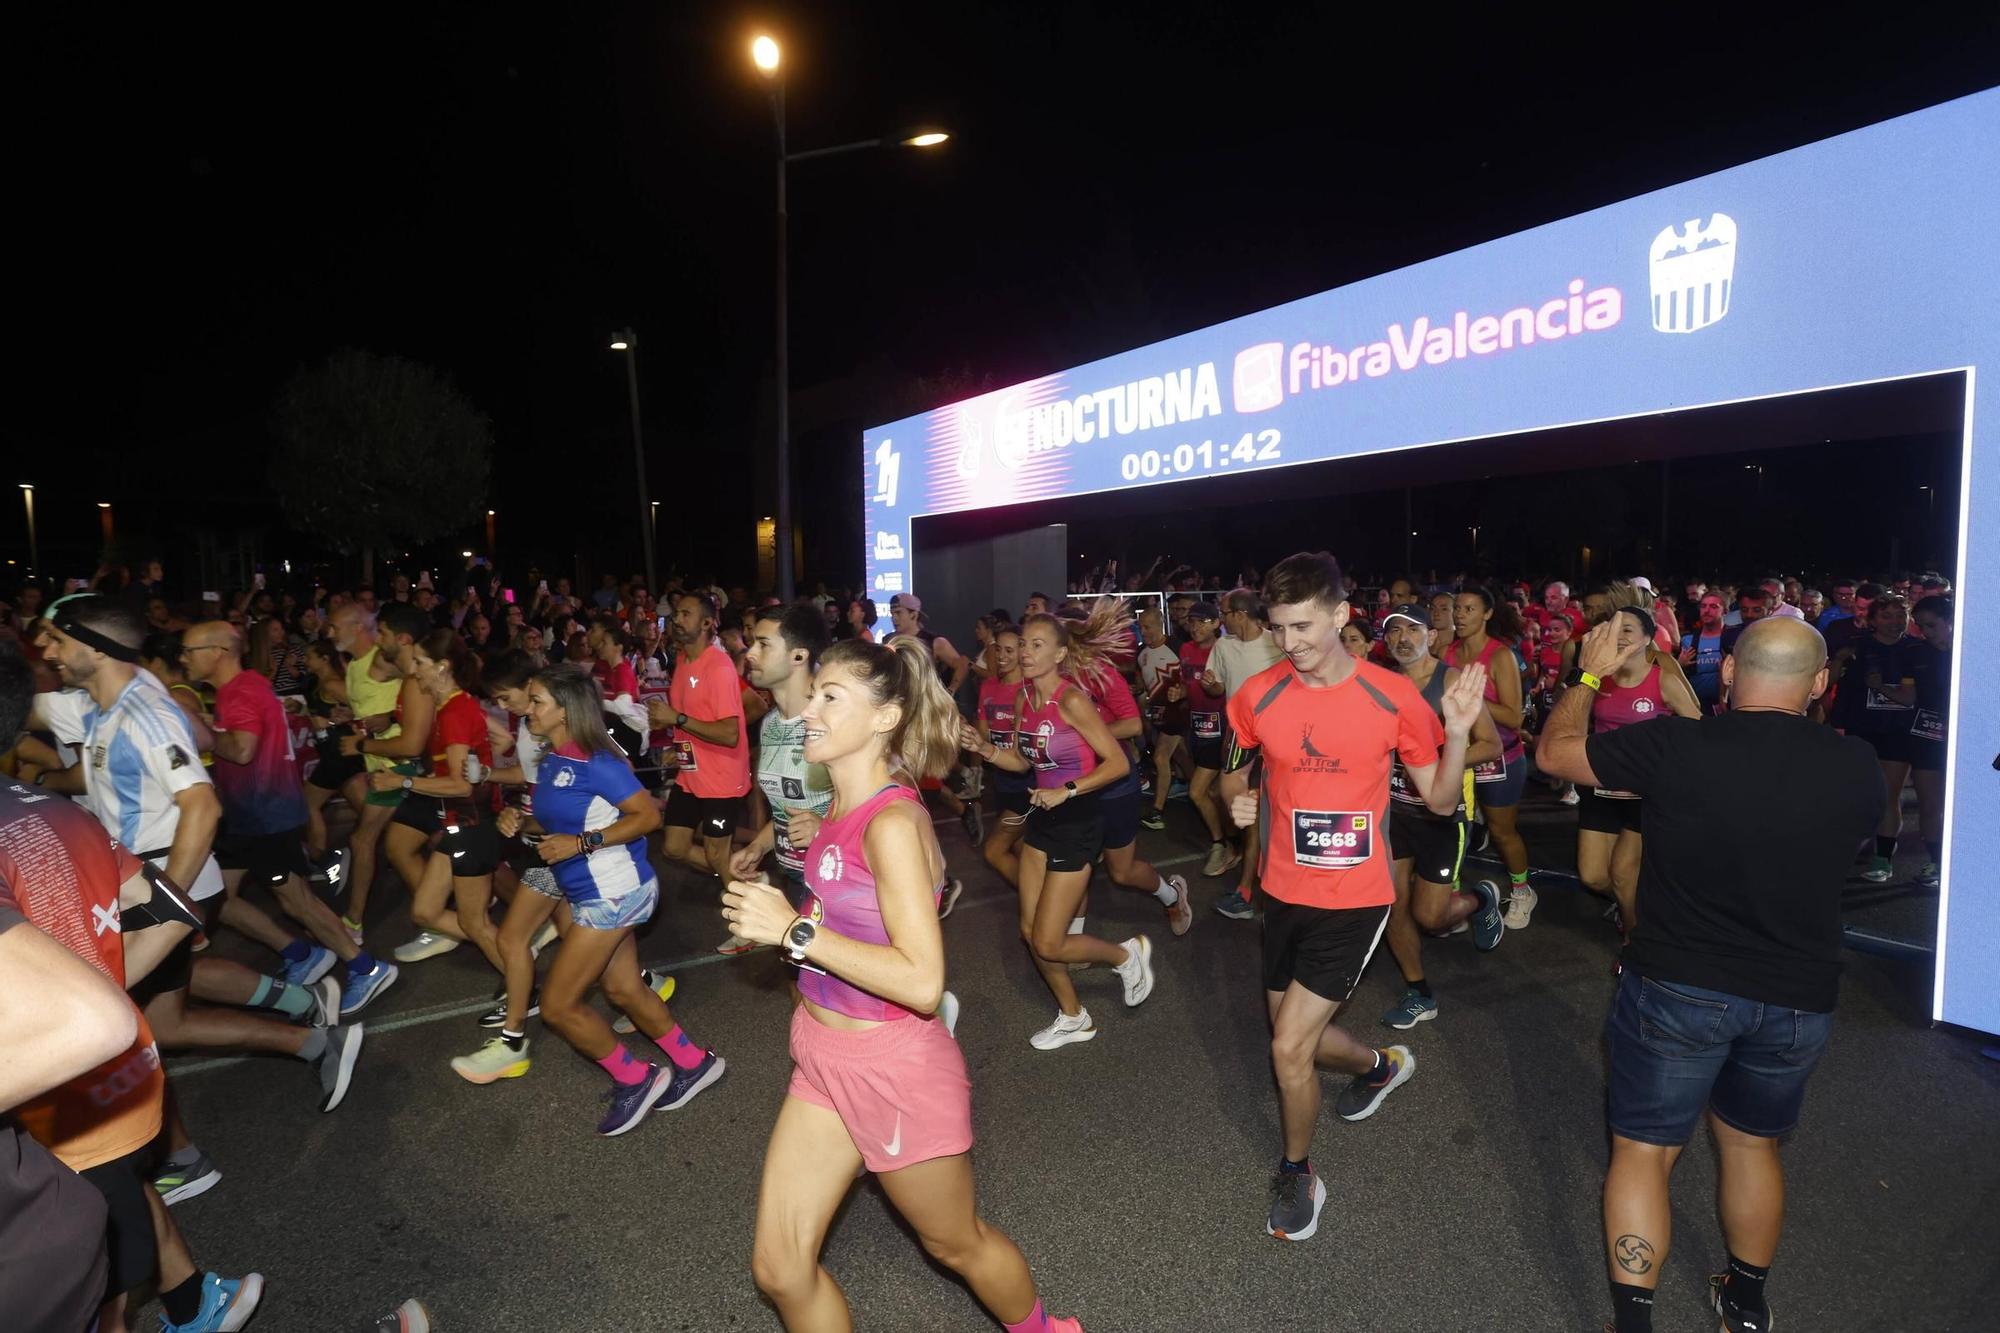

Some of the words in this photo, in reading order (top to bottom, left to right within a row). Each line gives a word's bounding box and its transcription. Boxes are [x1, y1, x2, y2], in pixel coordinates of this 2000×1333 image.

[1288, 278, 1623, 395] fibraValencia
[1033, 361, 1223, 452] NOCTURNA
[1121, 428, 1282, 481] 00:01:42
[1315, 757, 1342, 768] Trail
[1306, 831, 1357, 848] 2668
